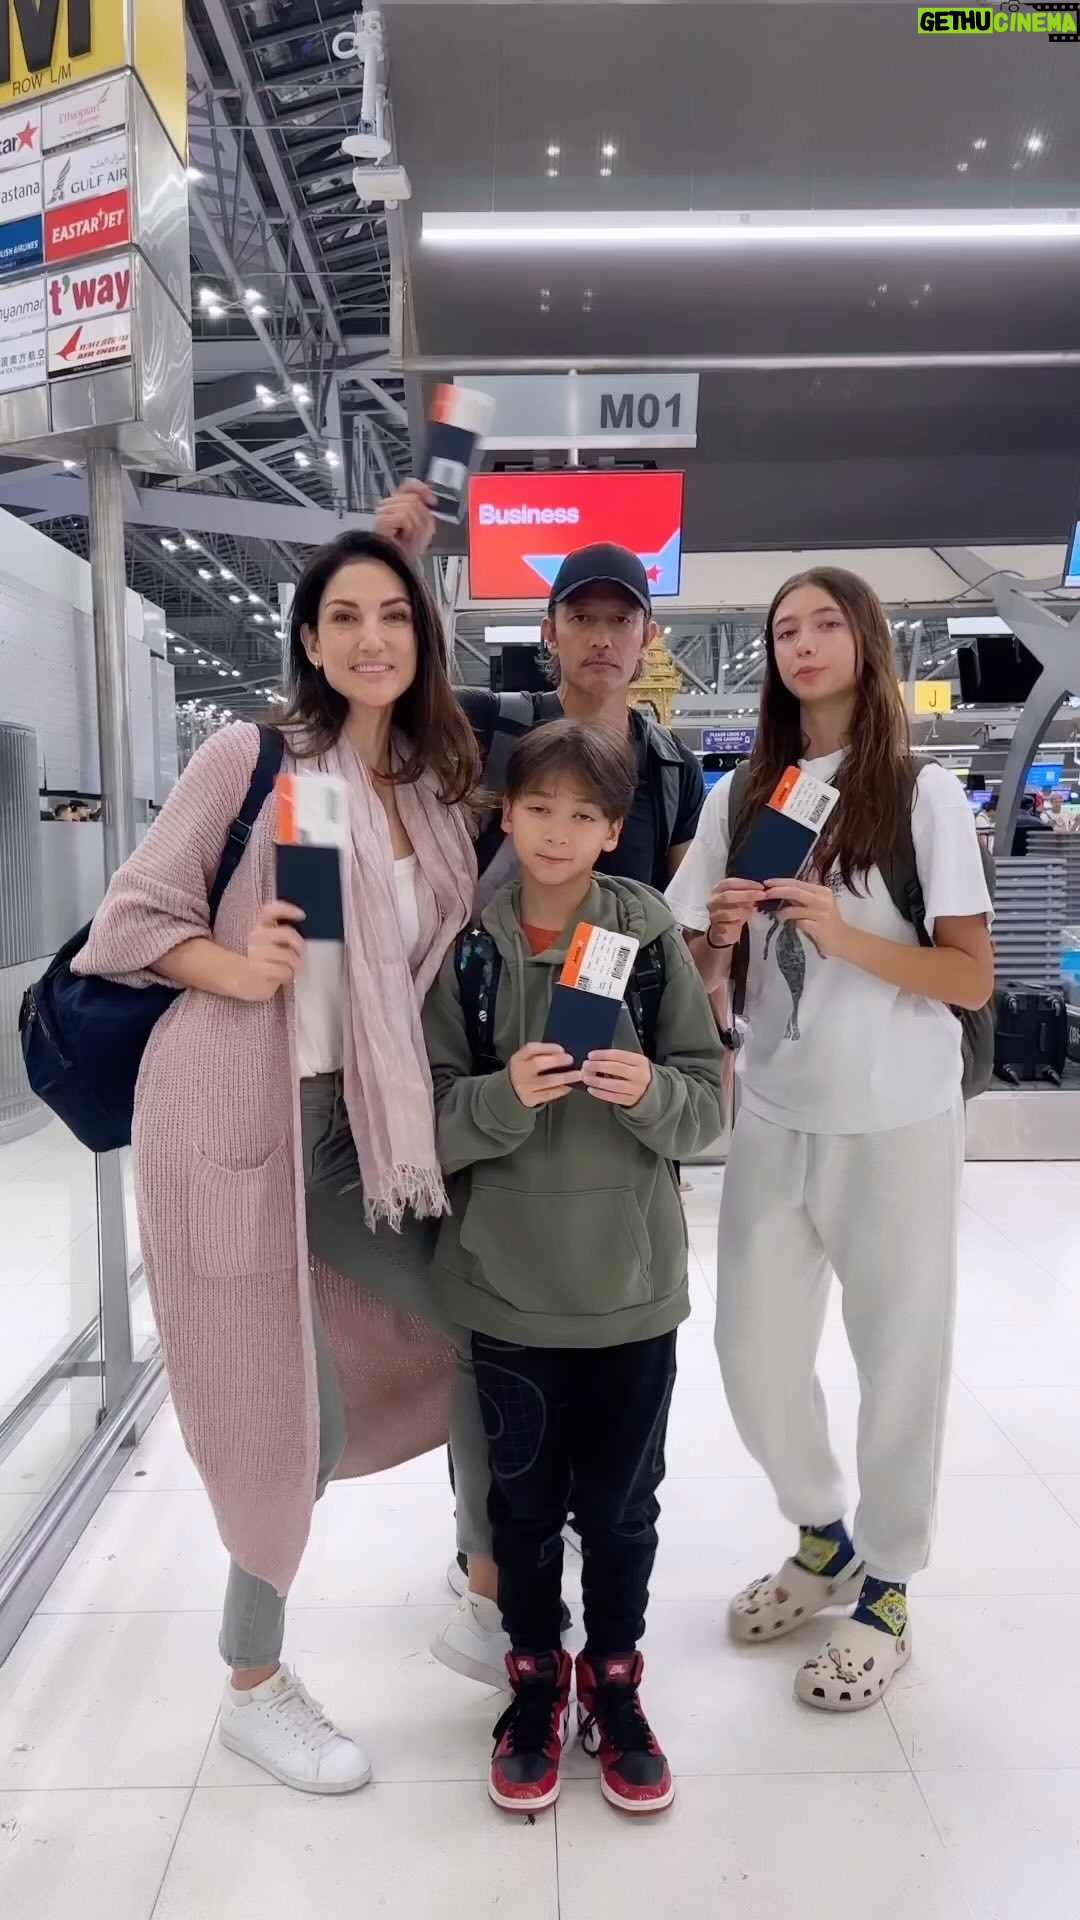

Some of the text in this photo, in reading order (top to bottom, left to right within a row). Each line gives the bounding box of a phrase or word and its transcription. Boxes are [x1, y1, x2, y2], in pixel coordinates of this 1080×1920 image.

[12, 63, 72, 96] ROW L/M
[1, 182, 40, 204] astana
[71, 167, 129, 194] GULF AIR
[49, 269, 130, 317] t'way
[600, 393, 681, 429] M01
[478, 503, 580, 525] Business
[928, 689, 937, 708] J
